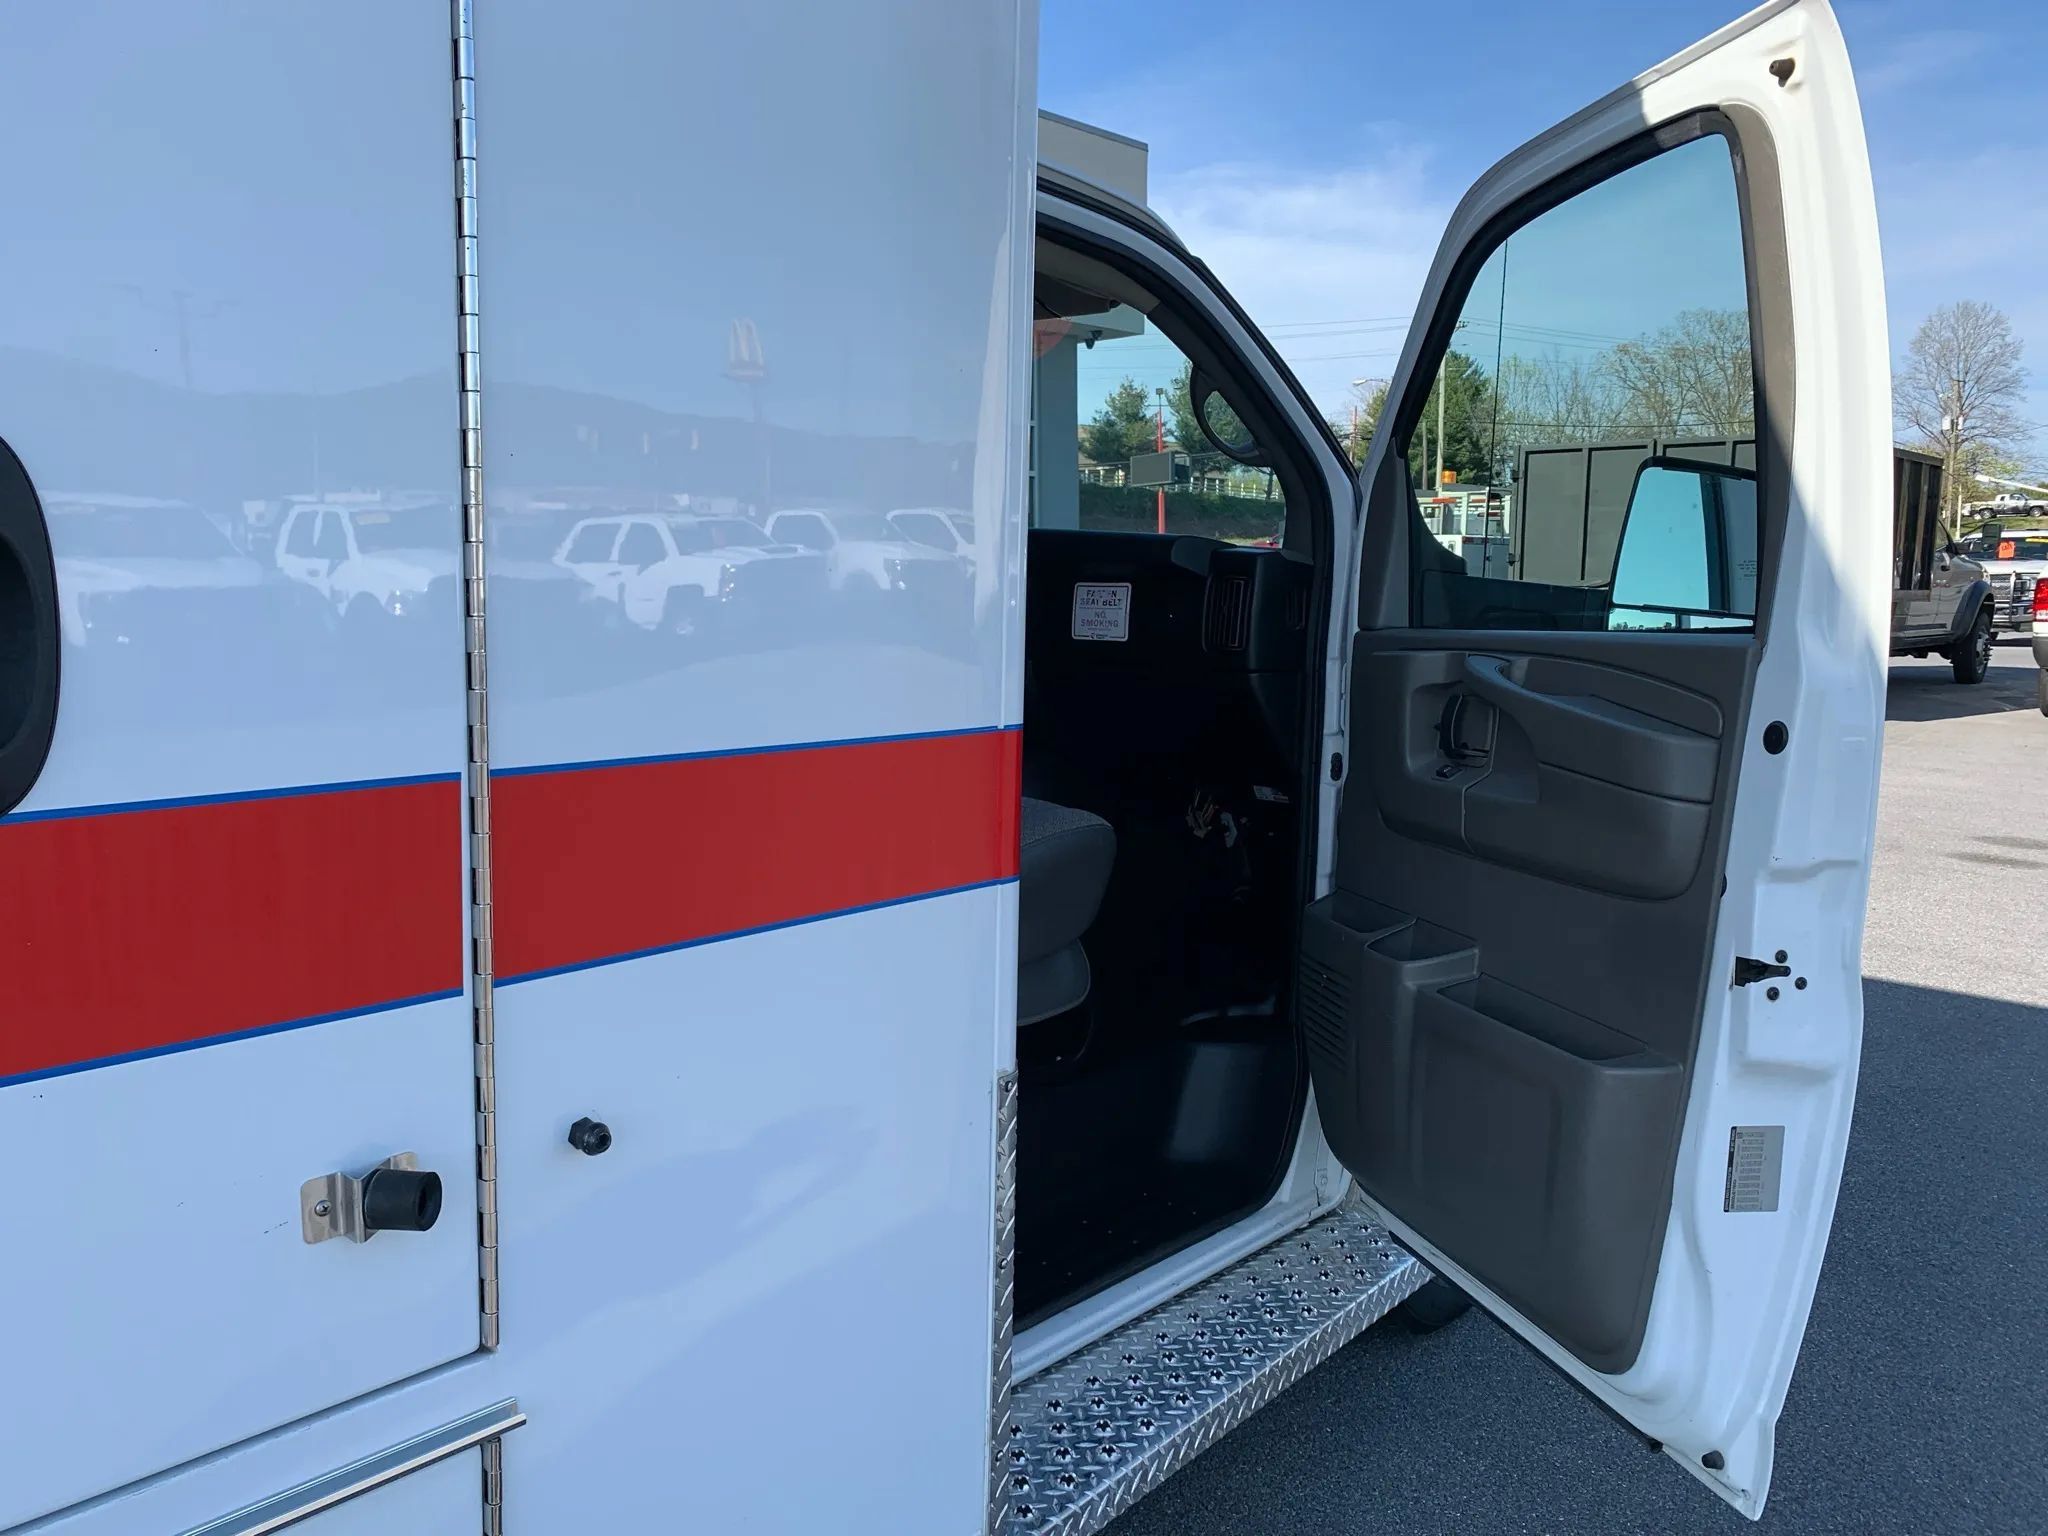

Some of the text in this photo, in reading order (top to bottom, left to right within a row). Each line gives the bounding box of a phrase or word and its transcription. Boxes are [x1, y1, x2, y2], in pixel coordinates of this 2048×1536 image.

[1086, 590, 1118, 598] FAN
[1102, 598, 1122, 606] BELT
[1094, 611, 1107, 619] NO
[1080, 618, 1119, 628] SMOKING
